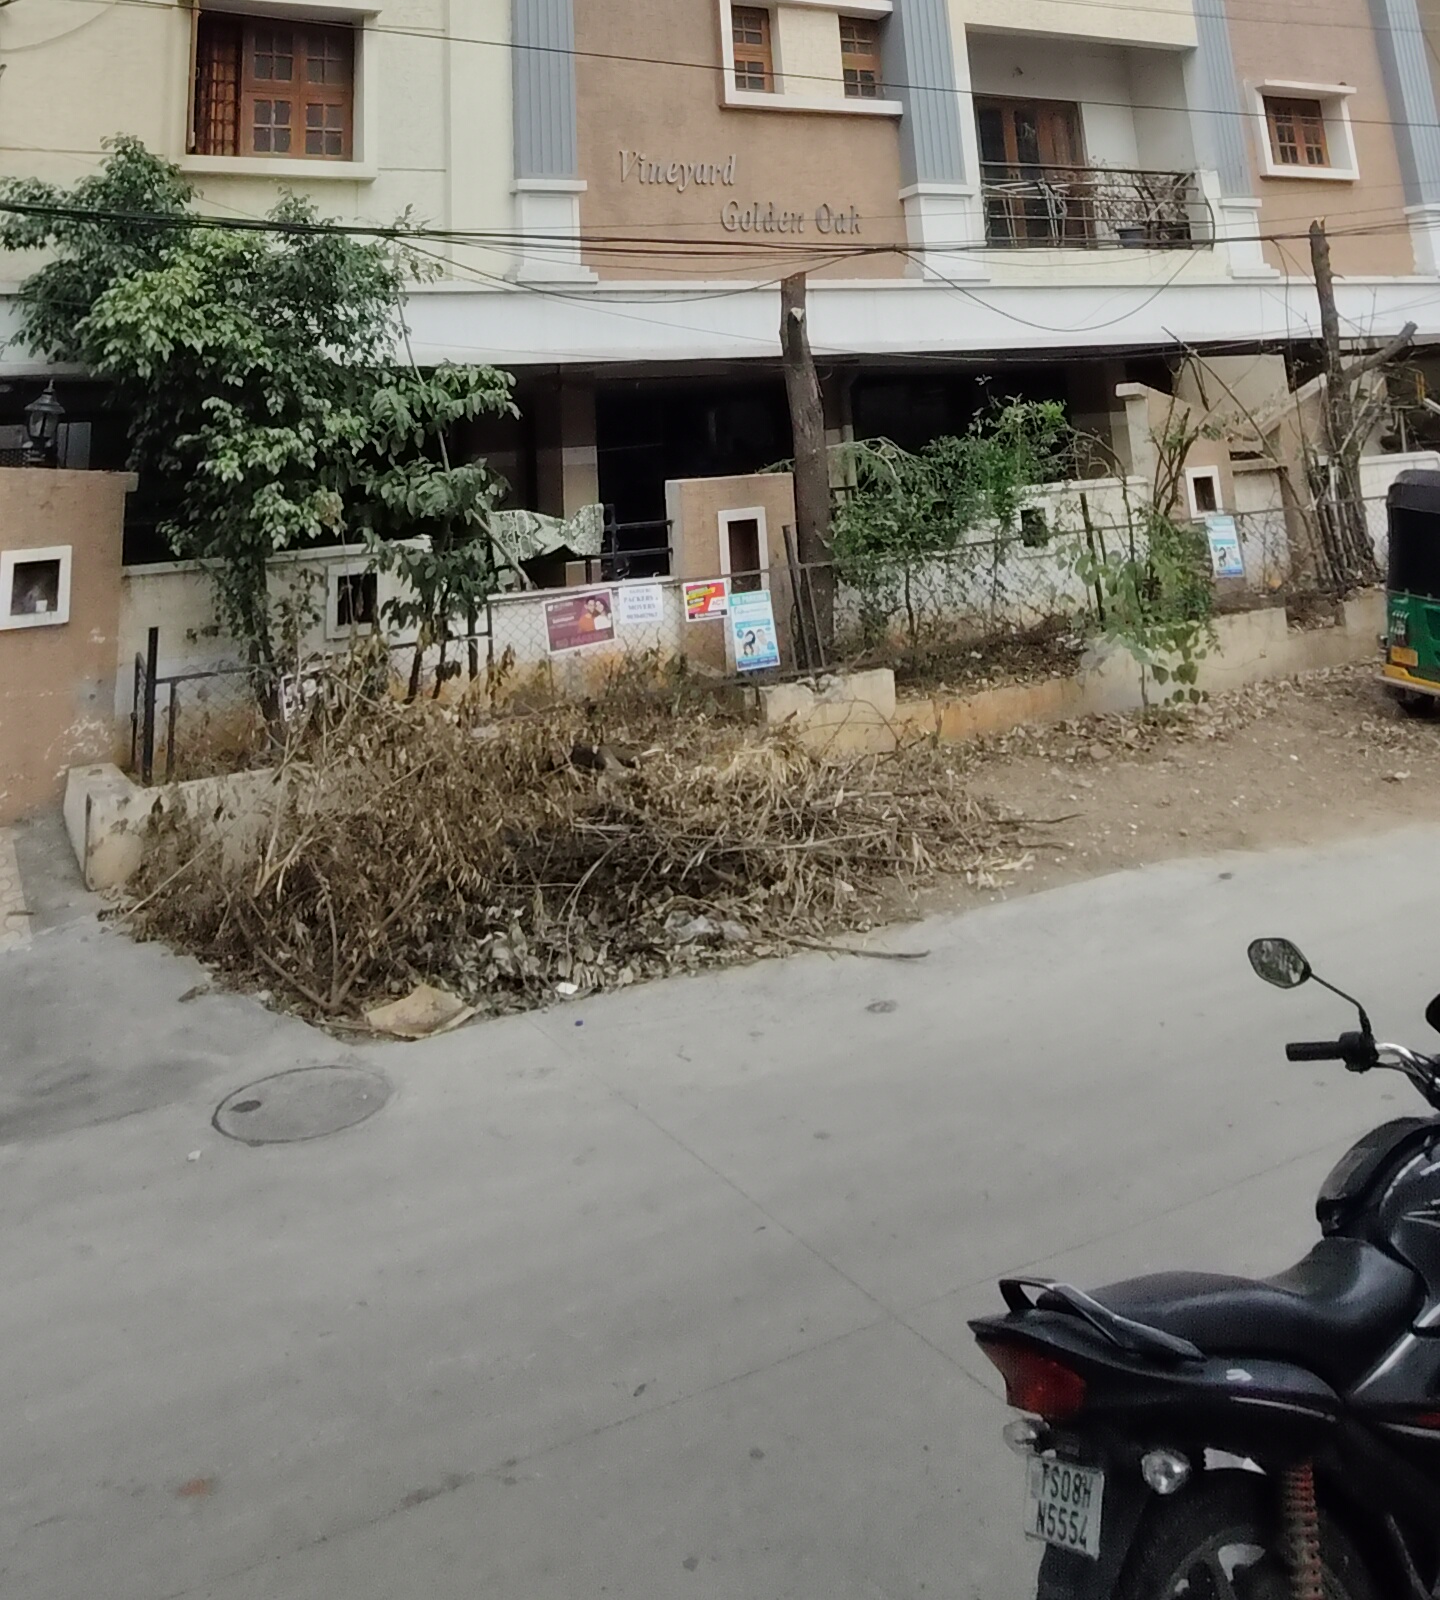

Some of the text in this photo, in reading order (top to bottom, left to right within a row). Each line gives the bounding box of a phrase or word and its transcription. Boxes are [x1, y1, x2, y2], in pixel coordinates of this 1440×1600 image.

[619, 150, 737, 193] Vineyard
[721, 200, 862, 234] Golden Oak
[1042, 1463, 1093, 1508] TS08H
[1036, 1500, 1088, 1550] N5554
